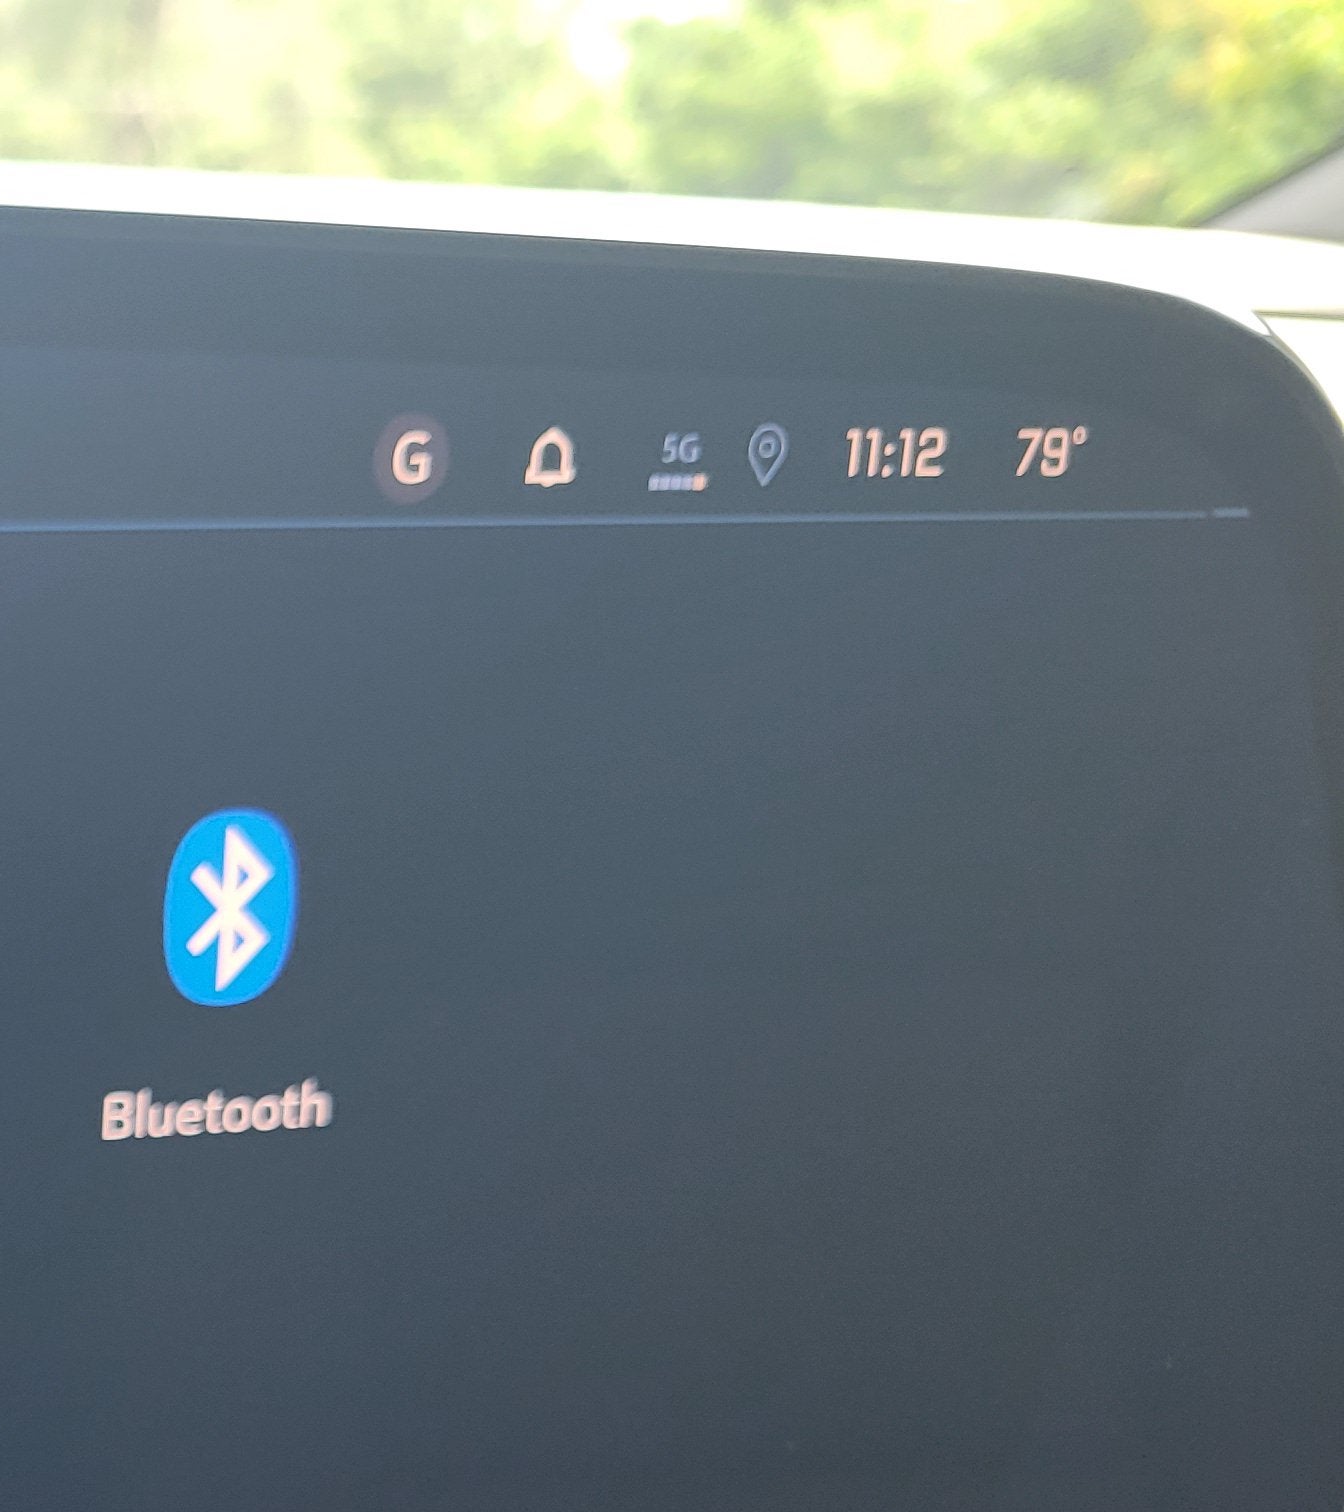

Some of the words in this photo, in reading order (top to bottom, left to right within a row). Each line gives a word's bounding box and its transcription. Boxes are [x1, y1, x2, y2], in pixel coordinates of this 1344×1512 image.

[392, 431, 432, 485] G
[662, 433, 701, 464] 5G
[846, 427, 948, 478] 11:12
[100, 1077, 334, 1141] Bluetooth
